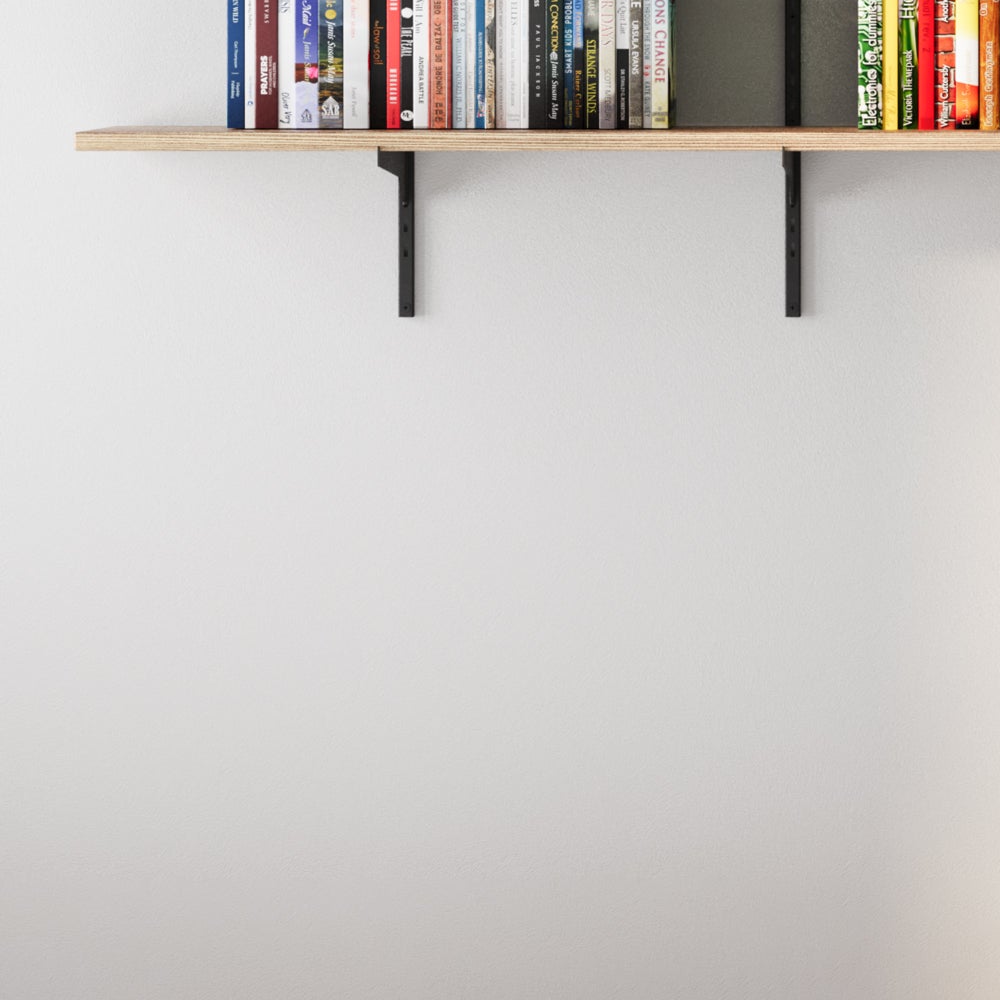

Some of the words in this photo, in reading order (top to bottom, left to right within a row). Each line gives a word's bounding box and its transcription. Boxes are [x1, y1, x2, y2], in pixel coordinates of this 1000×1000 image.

[302, 0, 312, 26] Maid
[980, 3, 988, 16] On
[326, 21, 336, 40] Janis
[374, 27, 384, 43] law
[434, 23, 442, 50] BALZAC
[550, 4, 559, 52] CONNECTION
[601, 14, 613, 46] DAYS
[862, 0, 877, 47] dummies
[401, 38, 413, 57] PEARL
[565, 29, 573, 46] KIDS
[327, 41, 336, 64] Susan
[374, 50, 384, 65] soil
[434, 54, 442, 62] DE
[565, 50, 573, 74] SMART
[588, 40, 596, 78] STRANGE
[655, 30, 667, 83] CHANGE
[862, 51, 877, 65] for
[260, 56, 268, 95] PRAYERS
[325, 66, 336, 84] May
[550, 60, 559, 78] Janis
[903, 50, 913, 91] THEMEPARK
[941, 64, 951, 99] Cuttersby
[588, 82, 596, 113] WINDS
[862, 69, 877, 126] Electronics
[903, 94, 913, 126] VICTORIA
[549, 102, 559, 120] May
[940, 101, 949, 127] William
